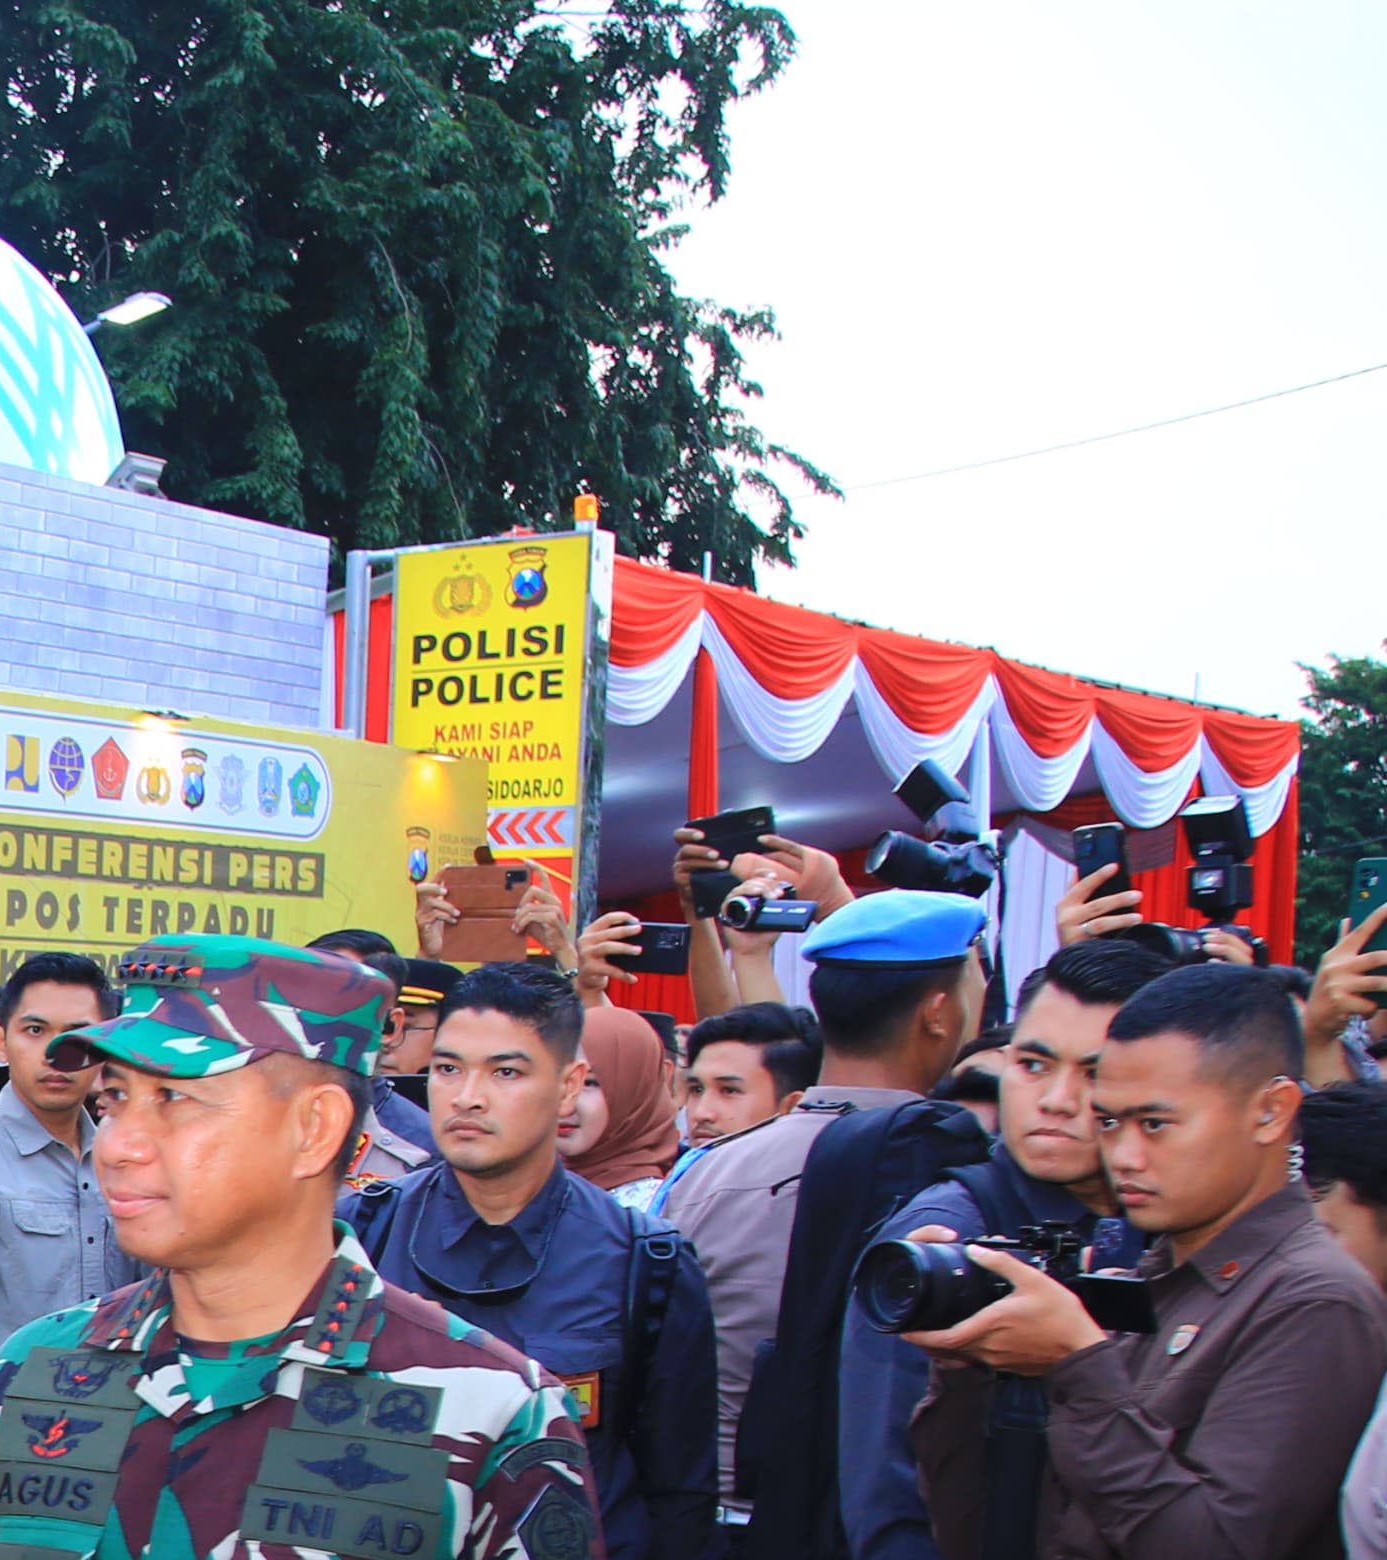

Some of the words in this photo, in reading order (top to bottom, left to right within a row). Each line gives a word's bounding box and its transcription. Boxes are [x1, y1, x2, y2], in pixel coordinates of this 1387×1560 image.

[411, 624, 565, 666] POLISI
[411, 669, 565, 708] POLICE
[433, 723, 483, 744] KAMI
[489, 720, 535, 740] SIAP
[508, 742, 563, 763] ANDA
[228, 853, 318, 893] PERS
[5, 889, 81, 932] POS
[103, 895, 276, 940] TERPADU
[261, 1498, 337, 1540] TNI
[354, 1514, 425, 1556] AD
